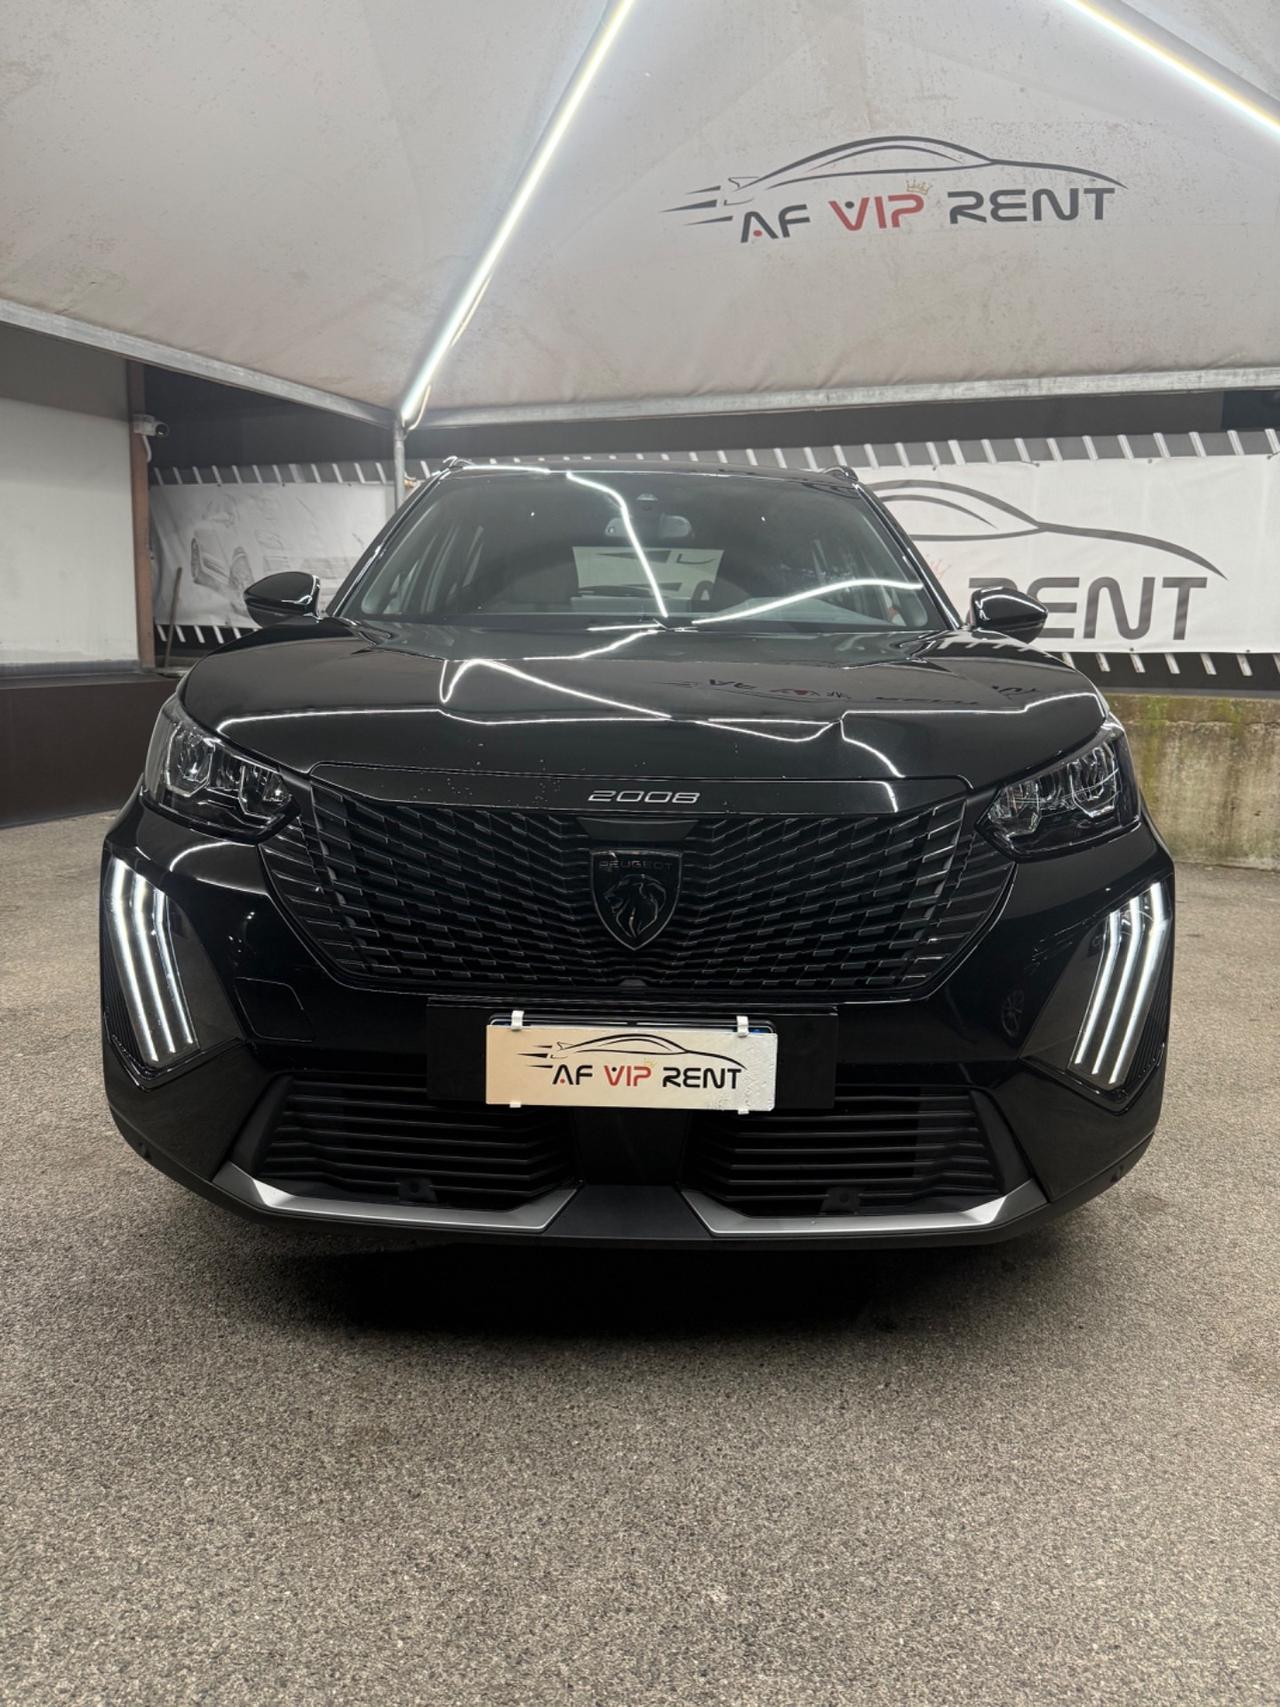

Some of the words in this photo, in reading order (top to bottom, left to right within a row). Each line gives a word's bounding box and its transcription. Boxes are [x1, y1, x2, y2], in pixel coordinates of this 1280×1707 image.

[740, 203, 811, 244] AF
[827, 193, 925, 232] VIP
[947, 187, 1116, 225] RENT
[587, 790, 701, 804] 2008
[552, 1064, 593, 1085] AF
[603, 1065, 652, 1087] VIP
[662, 1066, 743, 1089] RENT
